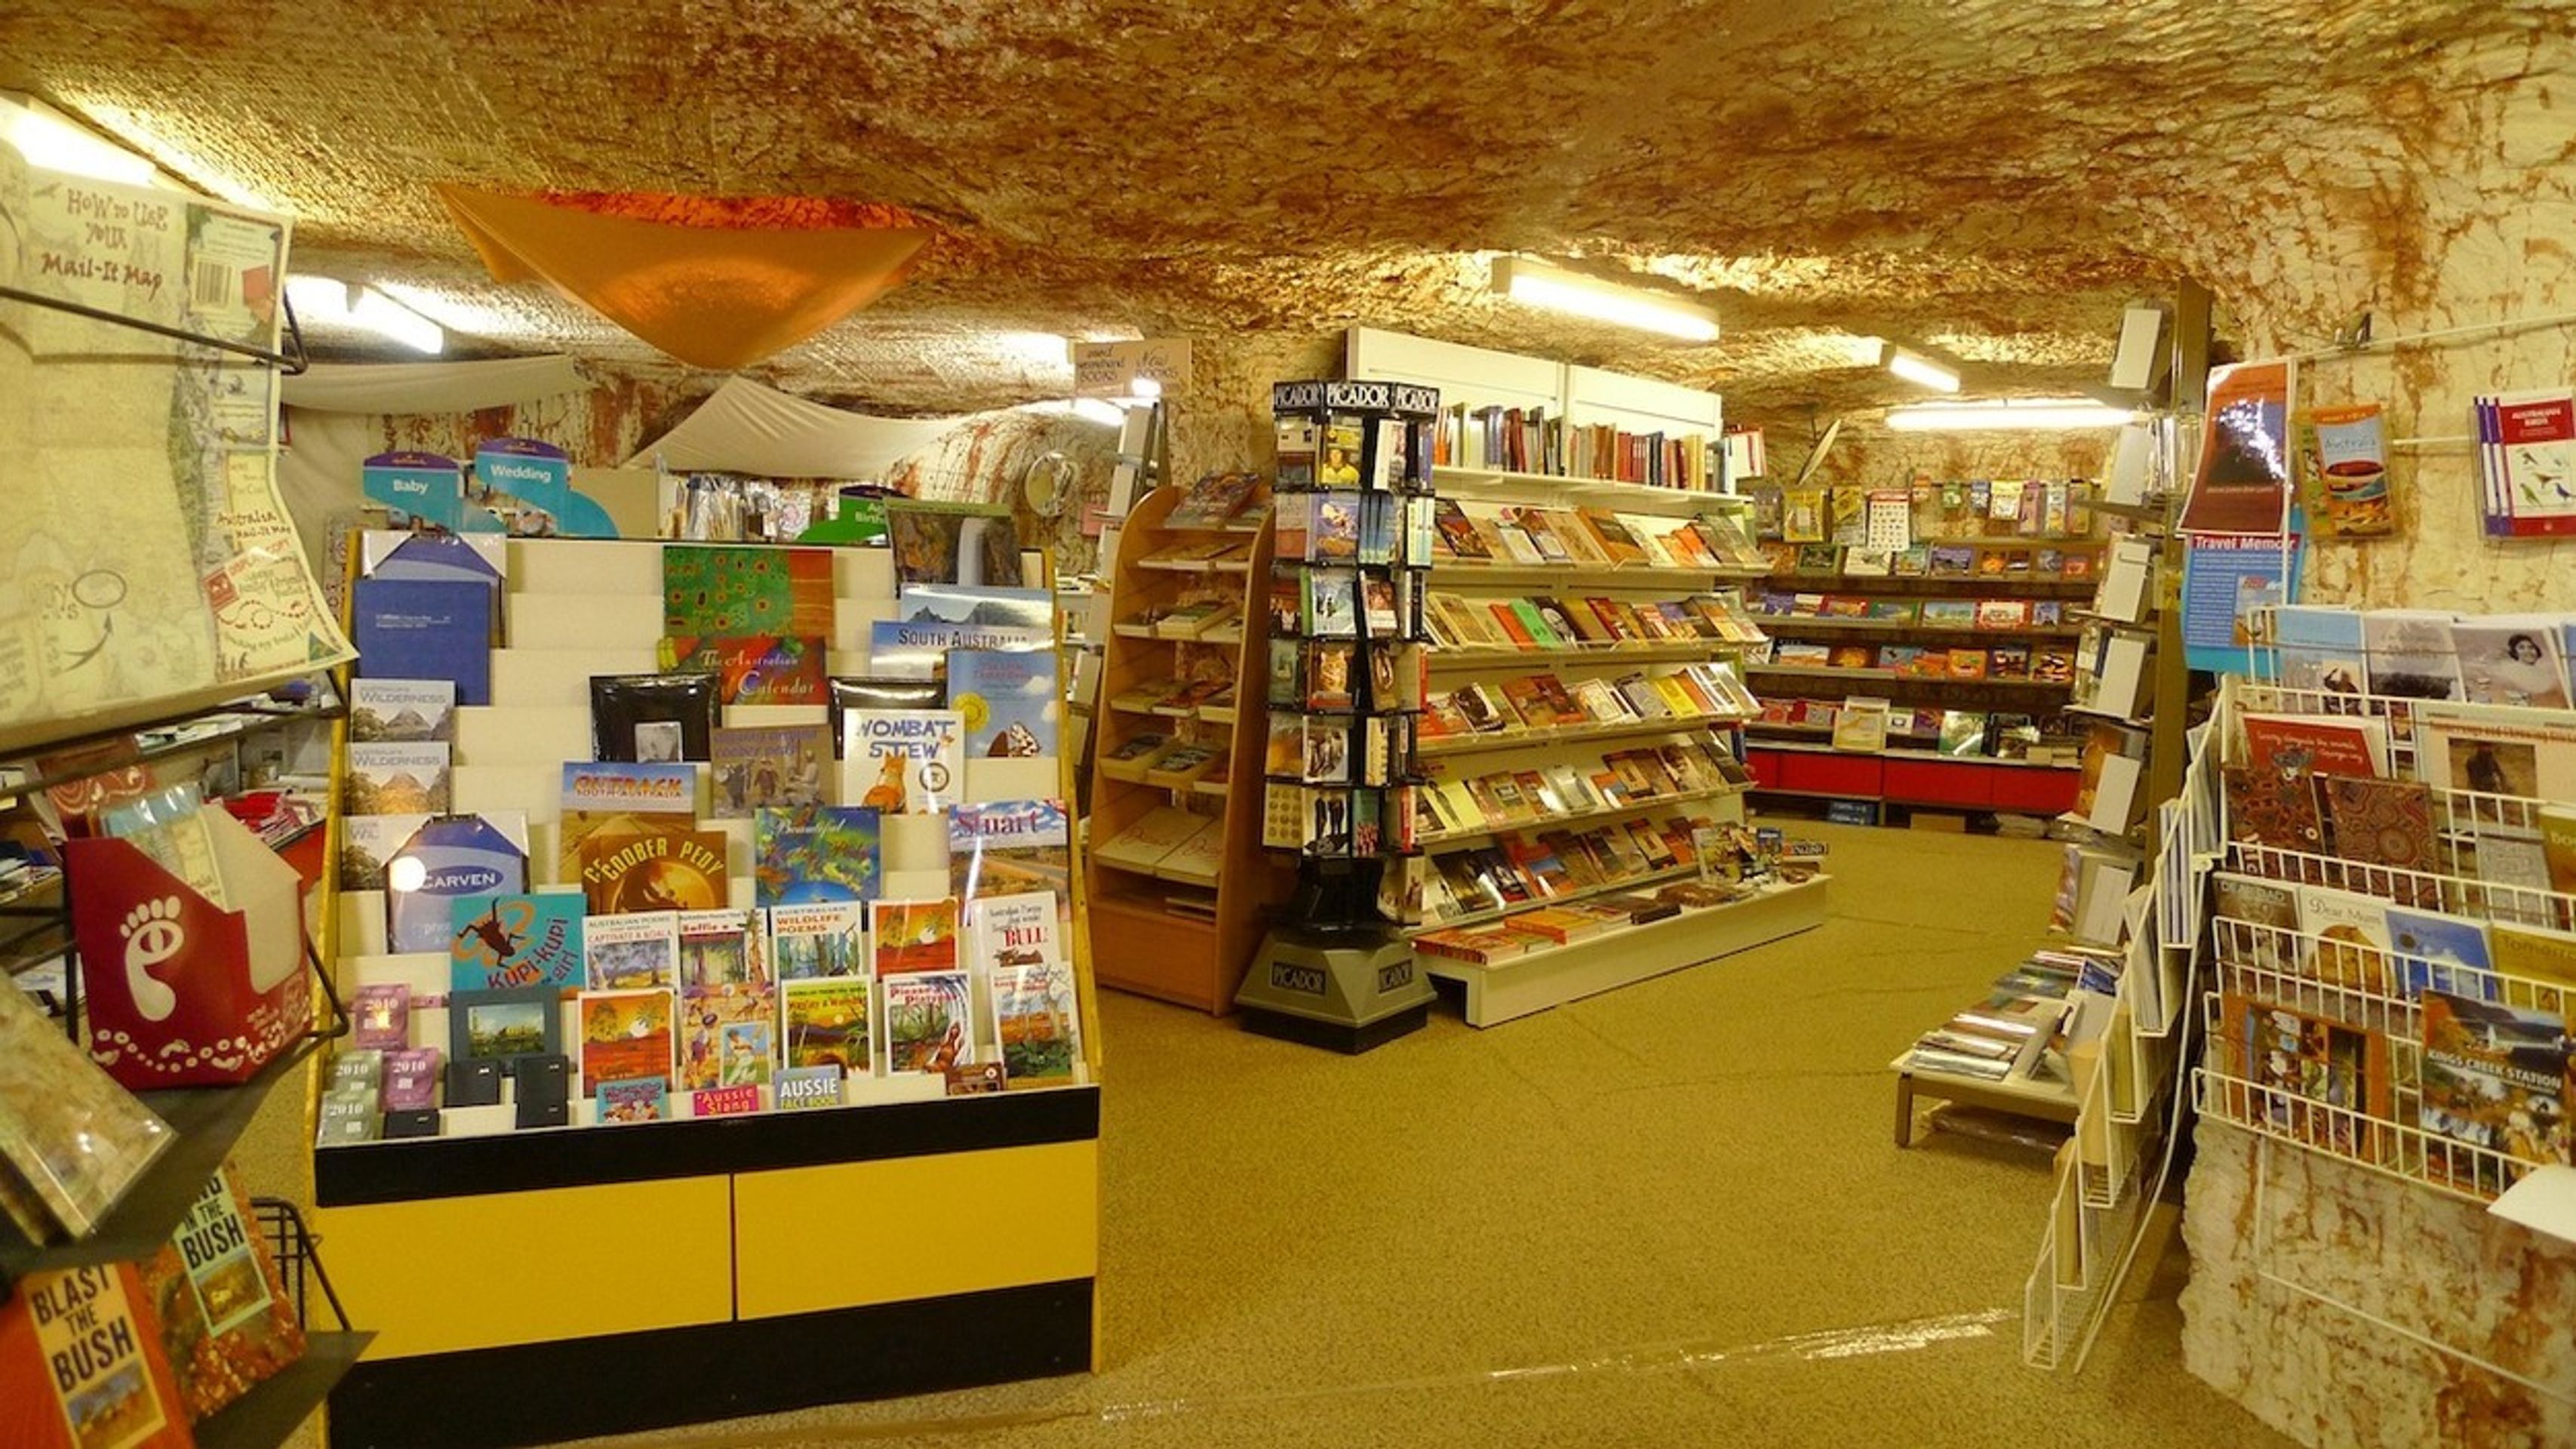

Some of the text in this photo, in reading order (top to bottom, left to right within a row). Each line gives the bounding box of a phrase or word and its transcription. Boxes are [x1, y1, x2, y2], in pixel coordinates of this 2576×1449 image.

[123, 264, 163, 303] Map
[1275, 384, 1320, 408] PICADOR
[1327, 383, 1391, 408] PICADOR
[1397, 384, 1438, 413] PICADOR
[490, 465, 552, 483] Wedding
[392, 479, 429, 494] Baby
[2194, 535, 2296, 551] Travel Memor
[898, 629, 947, 646] SOUTH
[700, 648, 800, 669] The Australian
[738, 669, 816, 696] Calendar
[856, 718, 958, 740] WOMBAT
[868, 740, 940, 759] STEW
[575, 775, 682, 792] OUTBACK
[957, 810, 1039, 838] Stuart
[601, 837, 667, 881] COOBER
[679, 841, 724, 875] PEDY
[777, 914, 840, 925] WILDLIFE
[777, 924, 827, 934] POEMS
[366, 998, 398, 1011] 2010
[336, 1063, 369, 1076] 2010
[392, 1060, 426, 1074] 2010
[780, 1078, 838, 1097] AUSSIE
[2503, 1068, 2562, 1090] STATION
[330, 1103, 364, 1117] 2010
[181, 1214, 245, 1271] BUSH
[31, 1265, 111, 1325] BLAST
[63, 1304, 99, 1337] THE
[51, 1316, 134, 1395] BUSH
